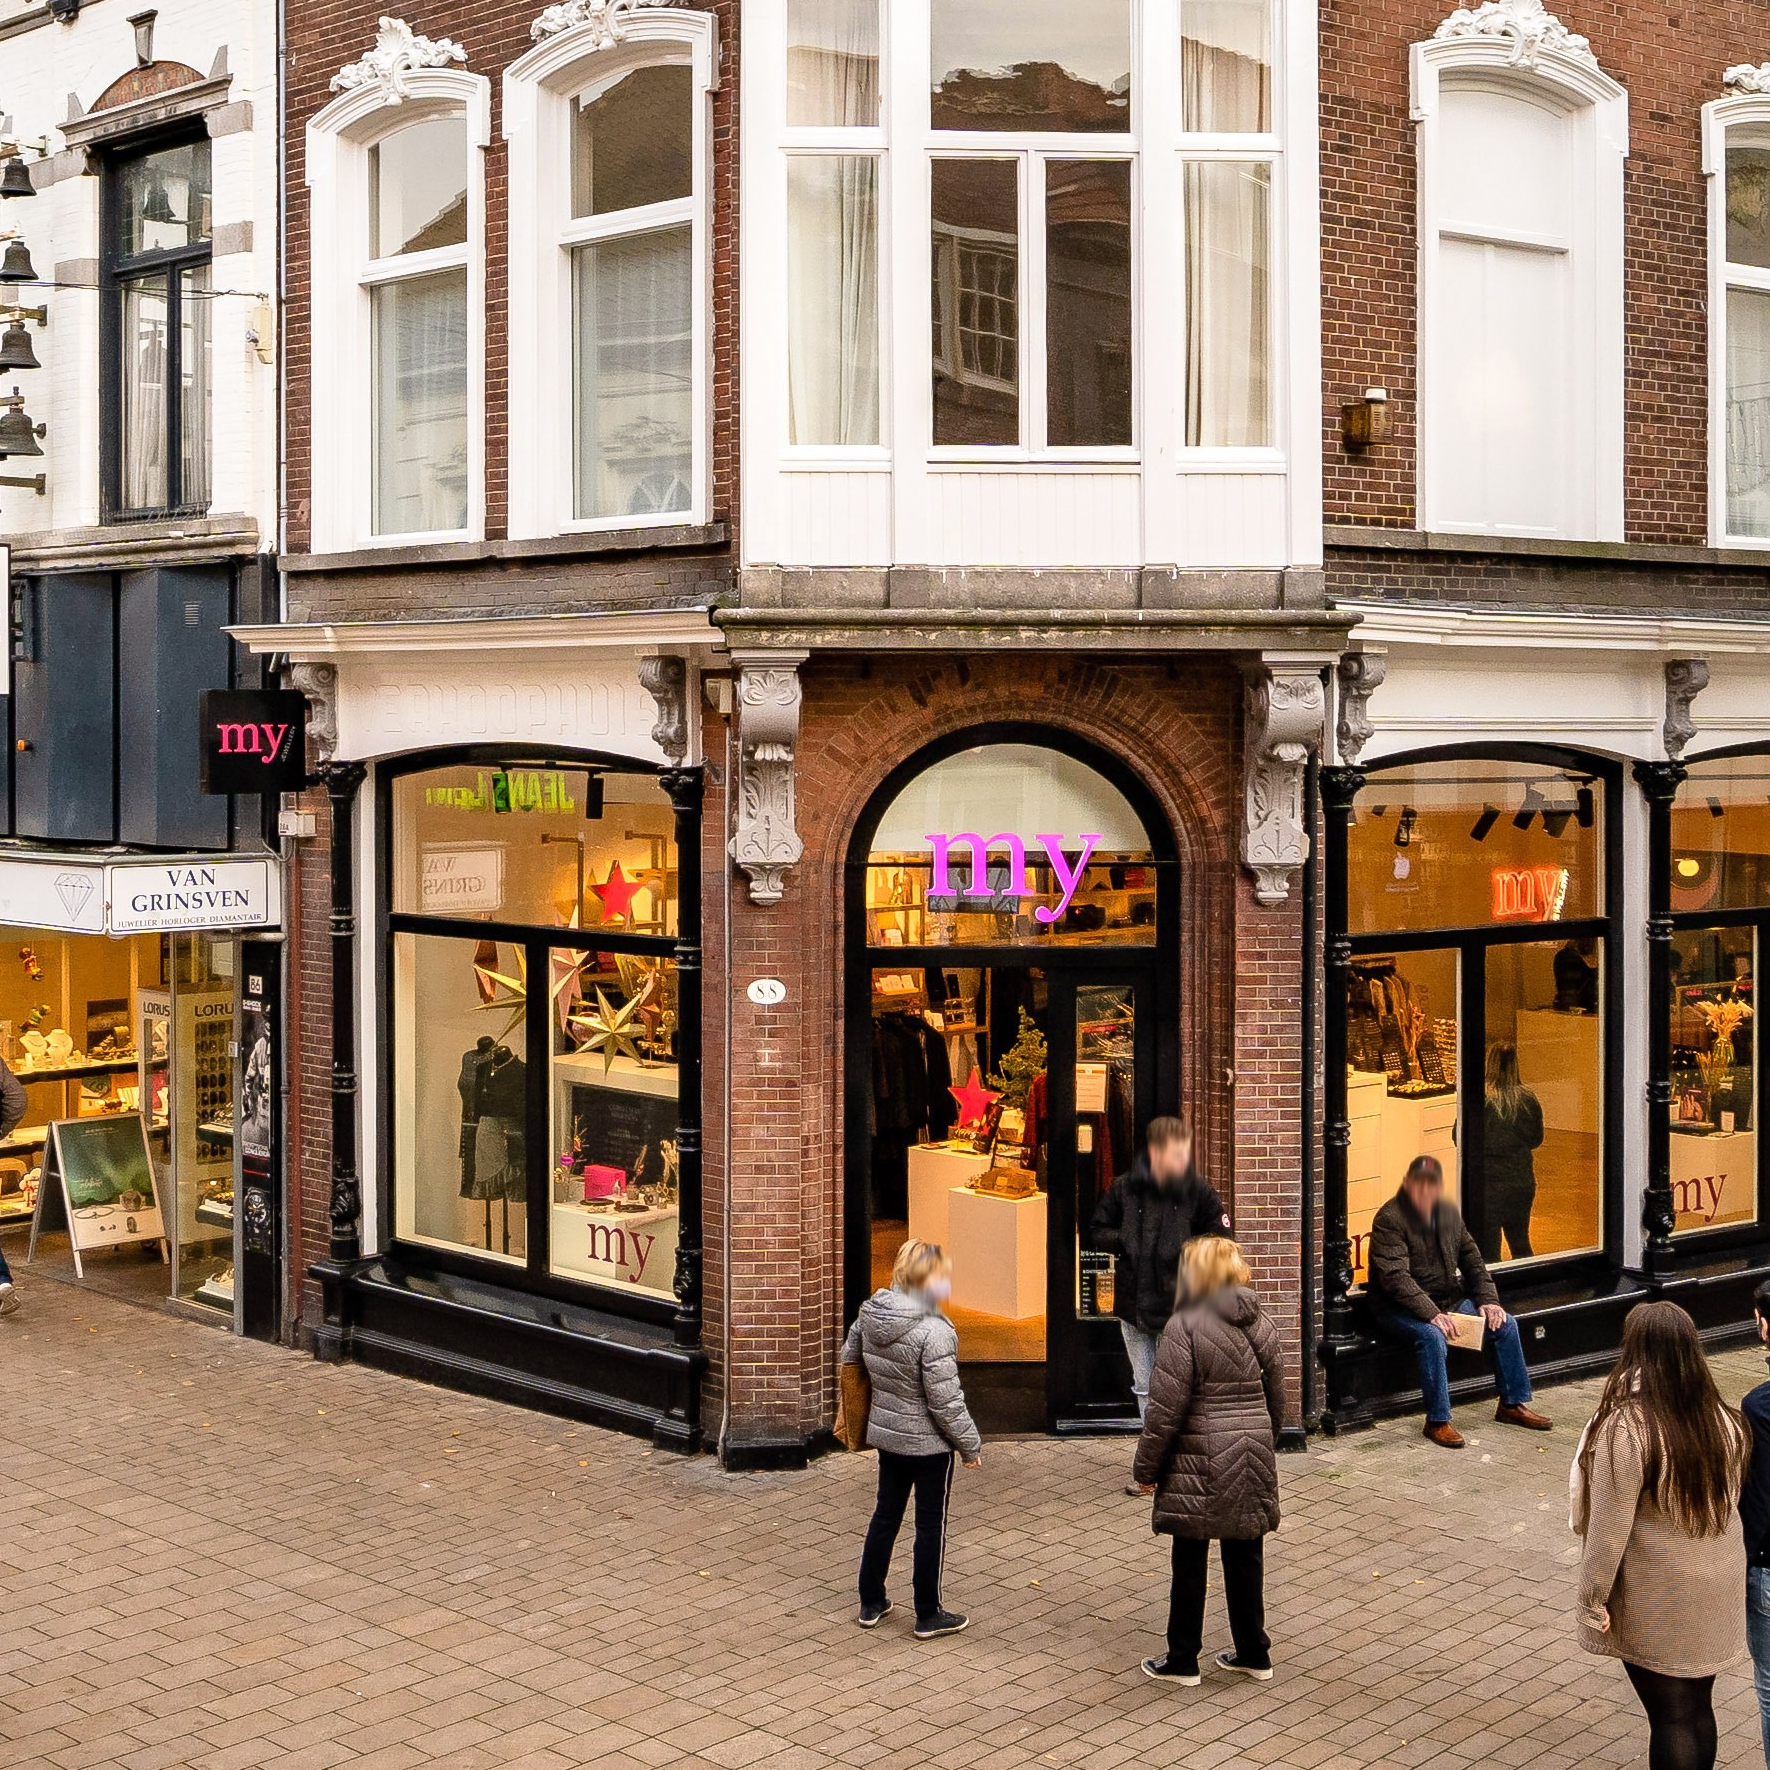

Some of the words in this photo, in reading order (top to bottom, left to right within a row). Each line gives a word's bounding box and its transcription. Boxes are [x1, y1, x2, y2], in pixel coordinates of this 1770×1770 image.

[216, 723, 288, 764] my
[166, 868, 216, 887] VAN
[924, 832, 1104, 923] my
[131, 889, 250, 913] GRINSVEN
[1496, 869, 1561, 922] my
[117, 919, 158, 929] JUWELIER
[161, 916, 206, 926] HORLOGER
[209, 913, 263, 924] DIAMANTAIR
[250, 978, 261, 991] 86
[756, 983, 777, 1000] 88
[143, 1001, 171, 1017] LORUS
[586, 1223, 656, 1284] my
